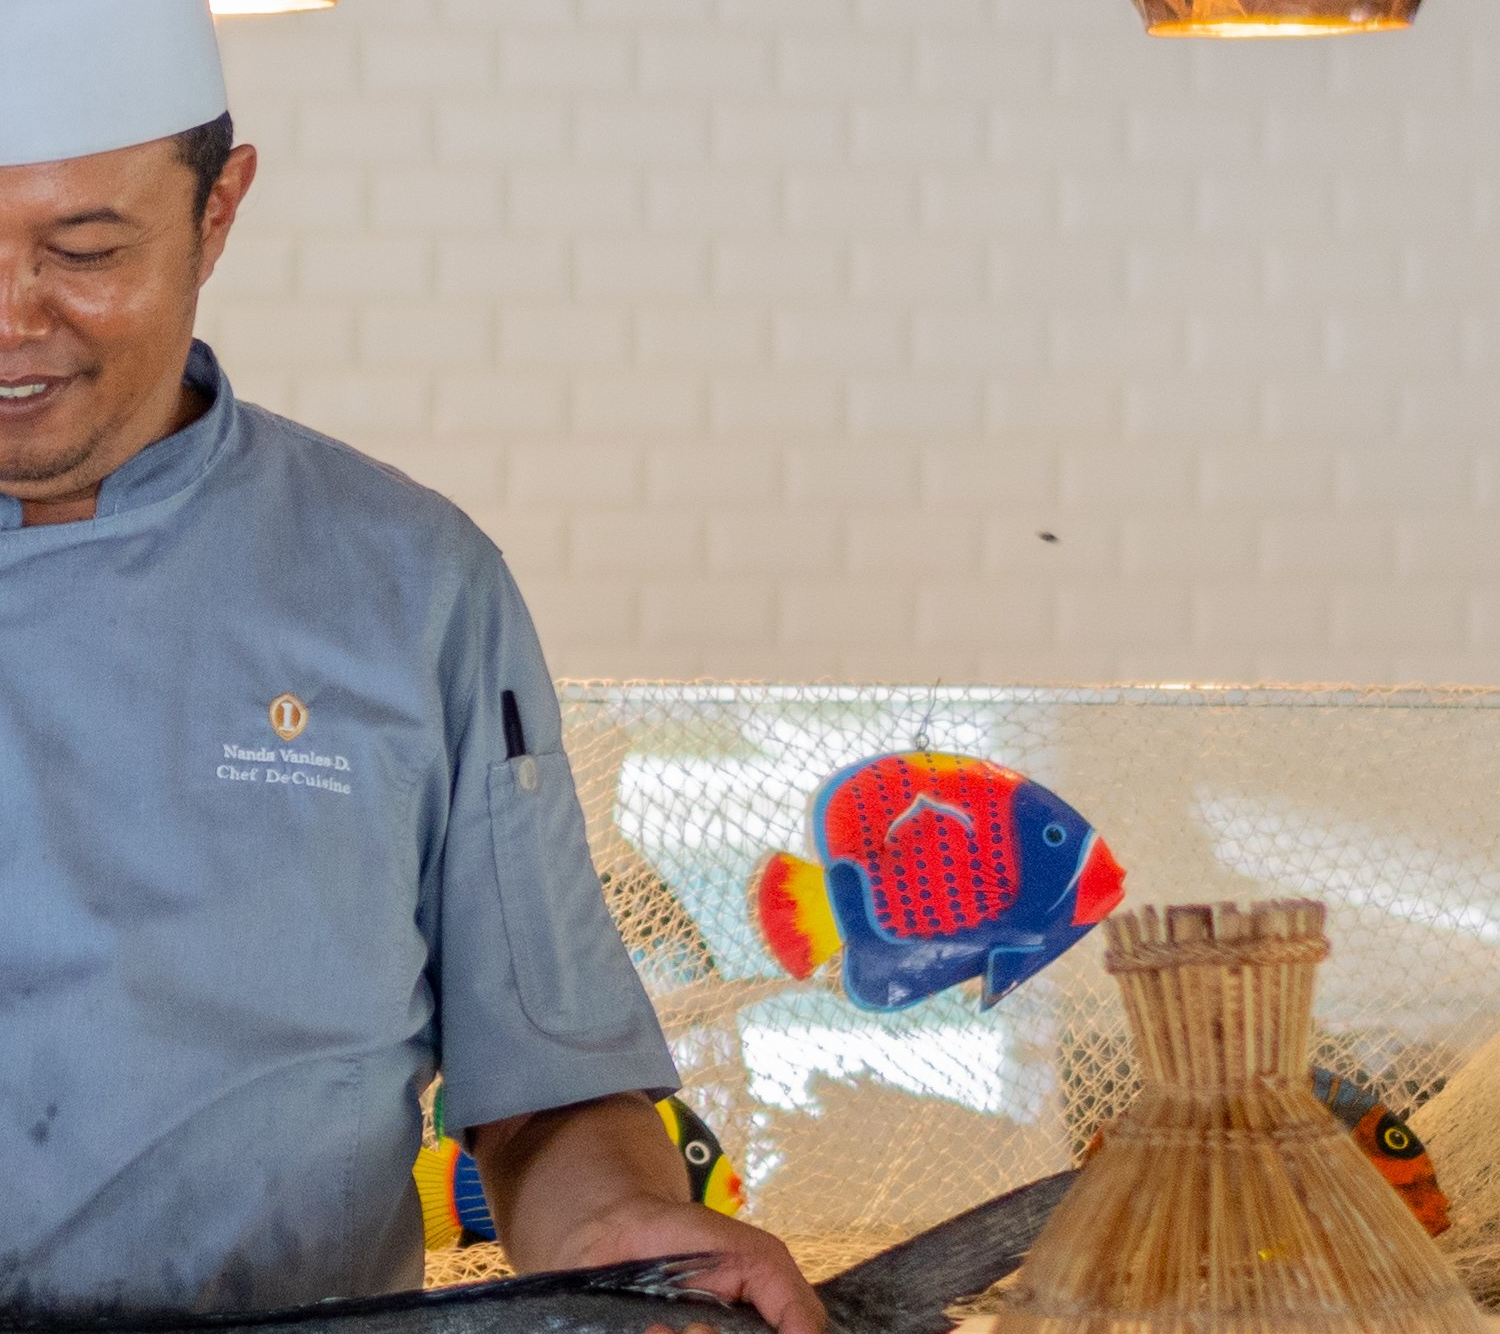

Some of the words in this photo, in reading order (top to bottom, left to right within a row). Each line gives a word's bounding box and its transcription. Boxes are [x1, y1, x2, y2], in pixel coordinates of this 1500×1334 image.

[222, 744, 276, 763] Nanda
[216, 765, 259, 782] Chef
[291, 771, 352, 795] Cuisine
